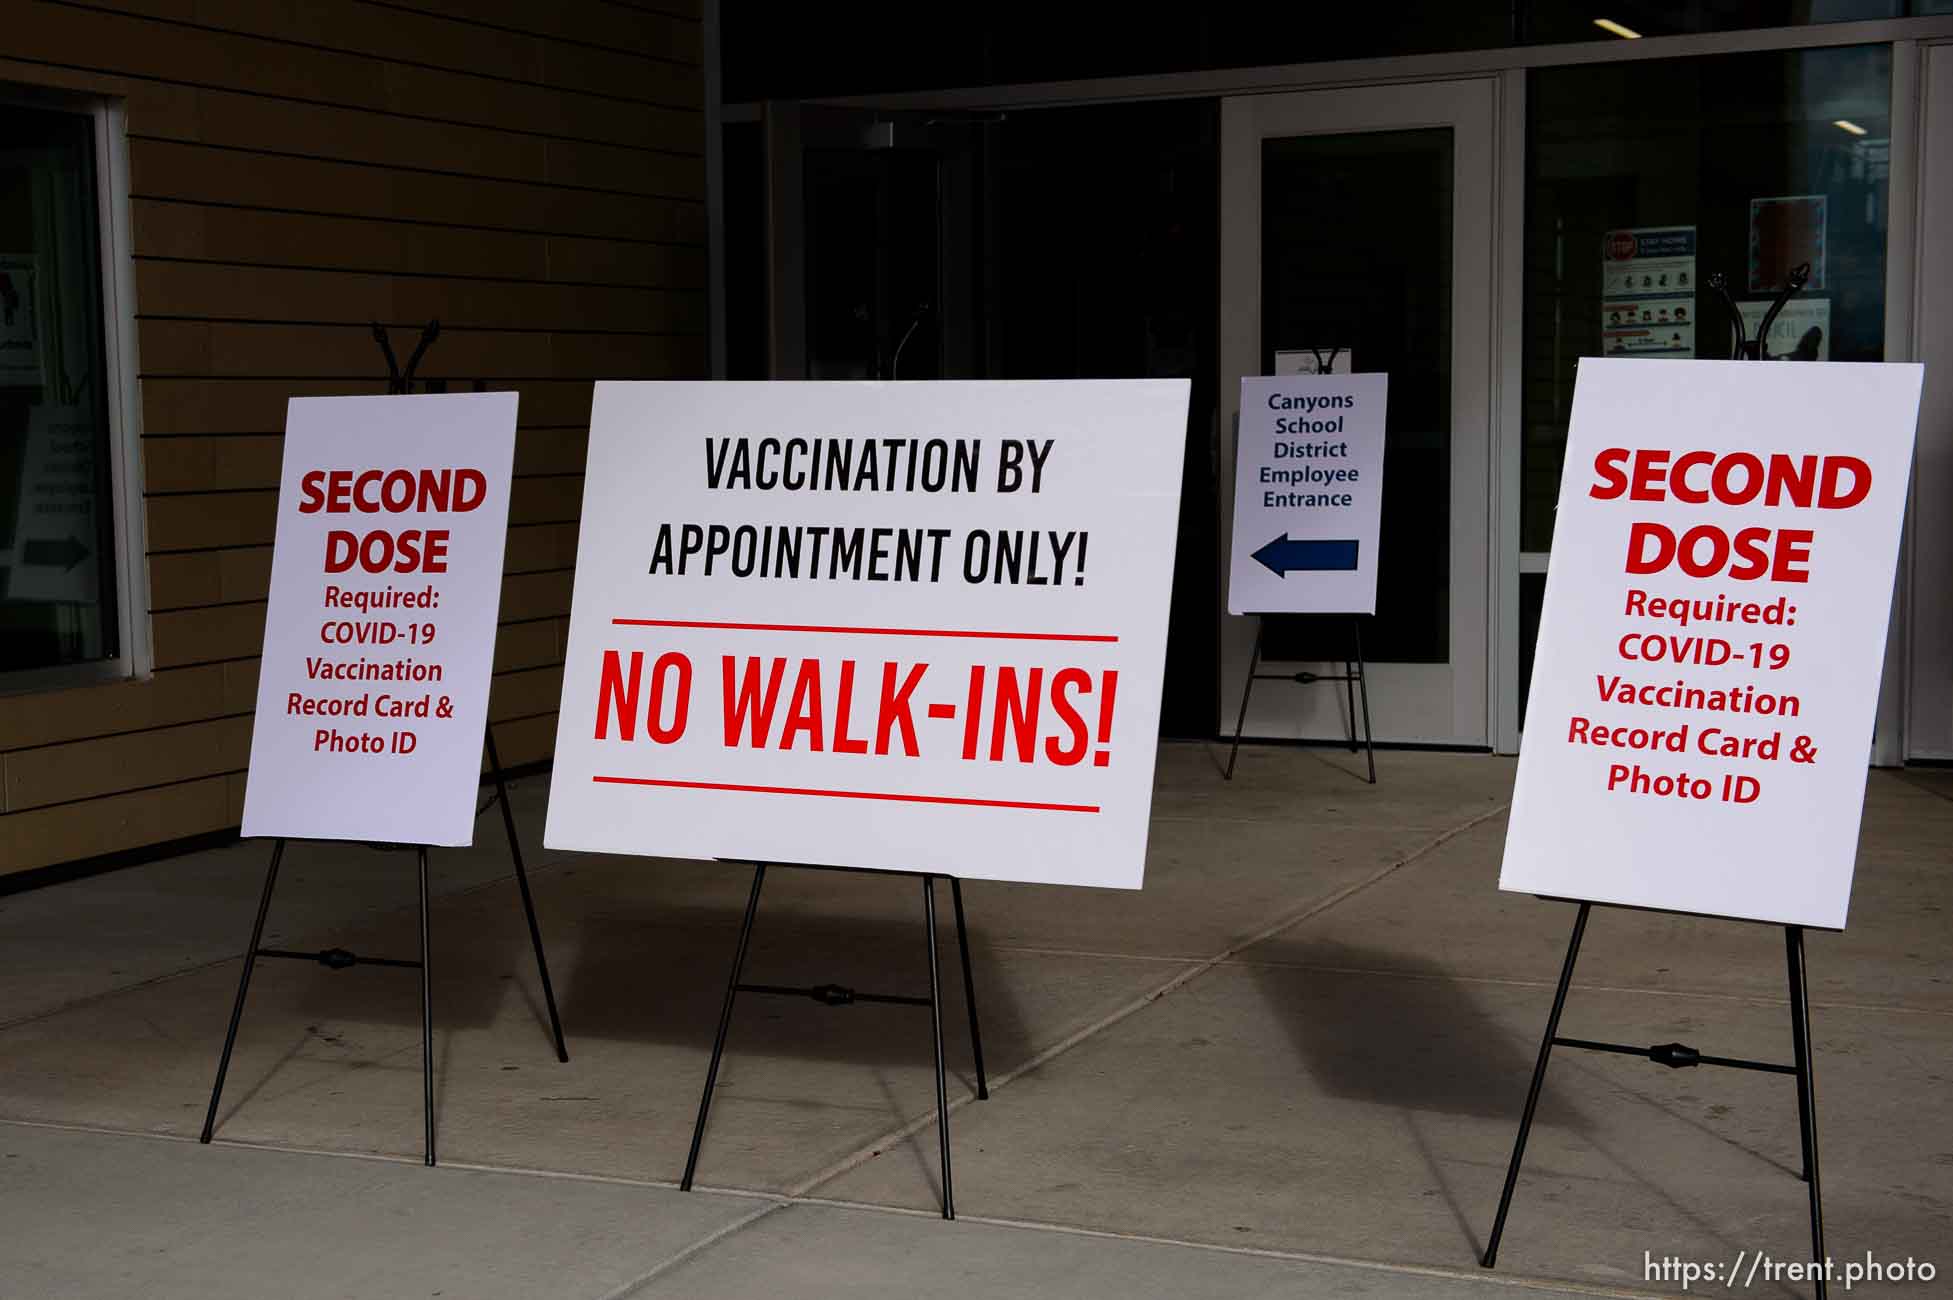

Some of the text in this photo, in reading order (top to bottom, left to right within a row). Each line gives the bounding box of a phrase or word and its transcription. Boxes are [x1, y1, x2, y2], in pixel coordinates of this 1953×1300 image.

[1268, 393, 1355, 413] Canyons
[1275, 415, 1344, 434] School
[705, 437, 1055, 494] VACCINATION BY
[1273, 441, 1348, 459] District
[297, 468, 488, 515] SECOND
[1259, 465, 1360, 487] Employee
[1588, 447, 1873, 510] SECOND
[1263, 490, 1353, 508] Entrance
[323, 529, 451, 574] DOSE
[648, 523, 1089, 587] APPOINTMENT ONLY!
[1624, 522, 1815, 584] DOSE
[324, 585, 440, 615] Required:
[1624, 589, 1798, 627] Required:
[320, 621, 436, 645] COVID-19
[1618, 633, 1791, 670] COVID-19
[305, 656, 443, 682] Vaccination
[287, 692, 454, 719] Record Card &
[594, 649, 1120, 768] NO WALK-INS!
[1596, 674, 1800, 717] Vaccination
[313, 729, 417, 755] Photo ID
[1567, 716, 1818, 764] Record Card &
[1607, 764, 1761, 804] Photo ID
